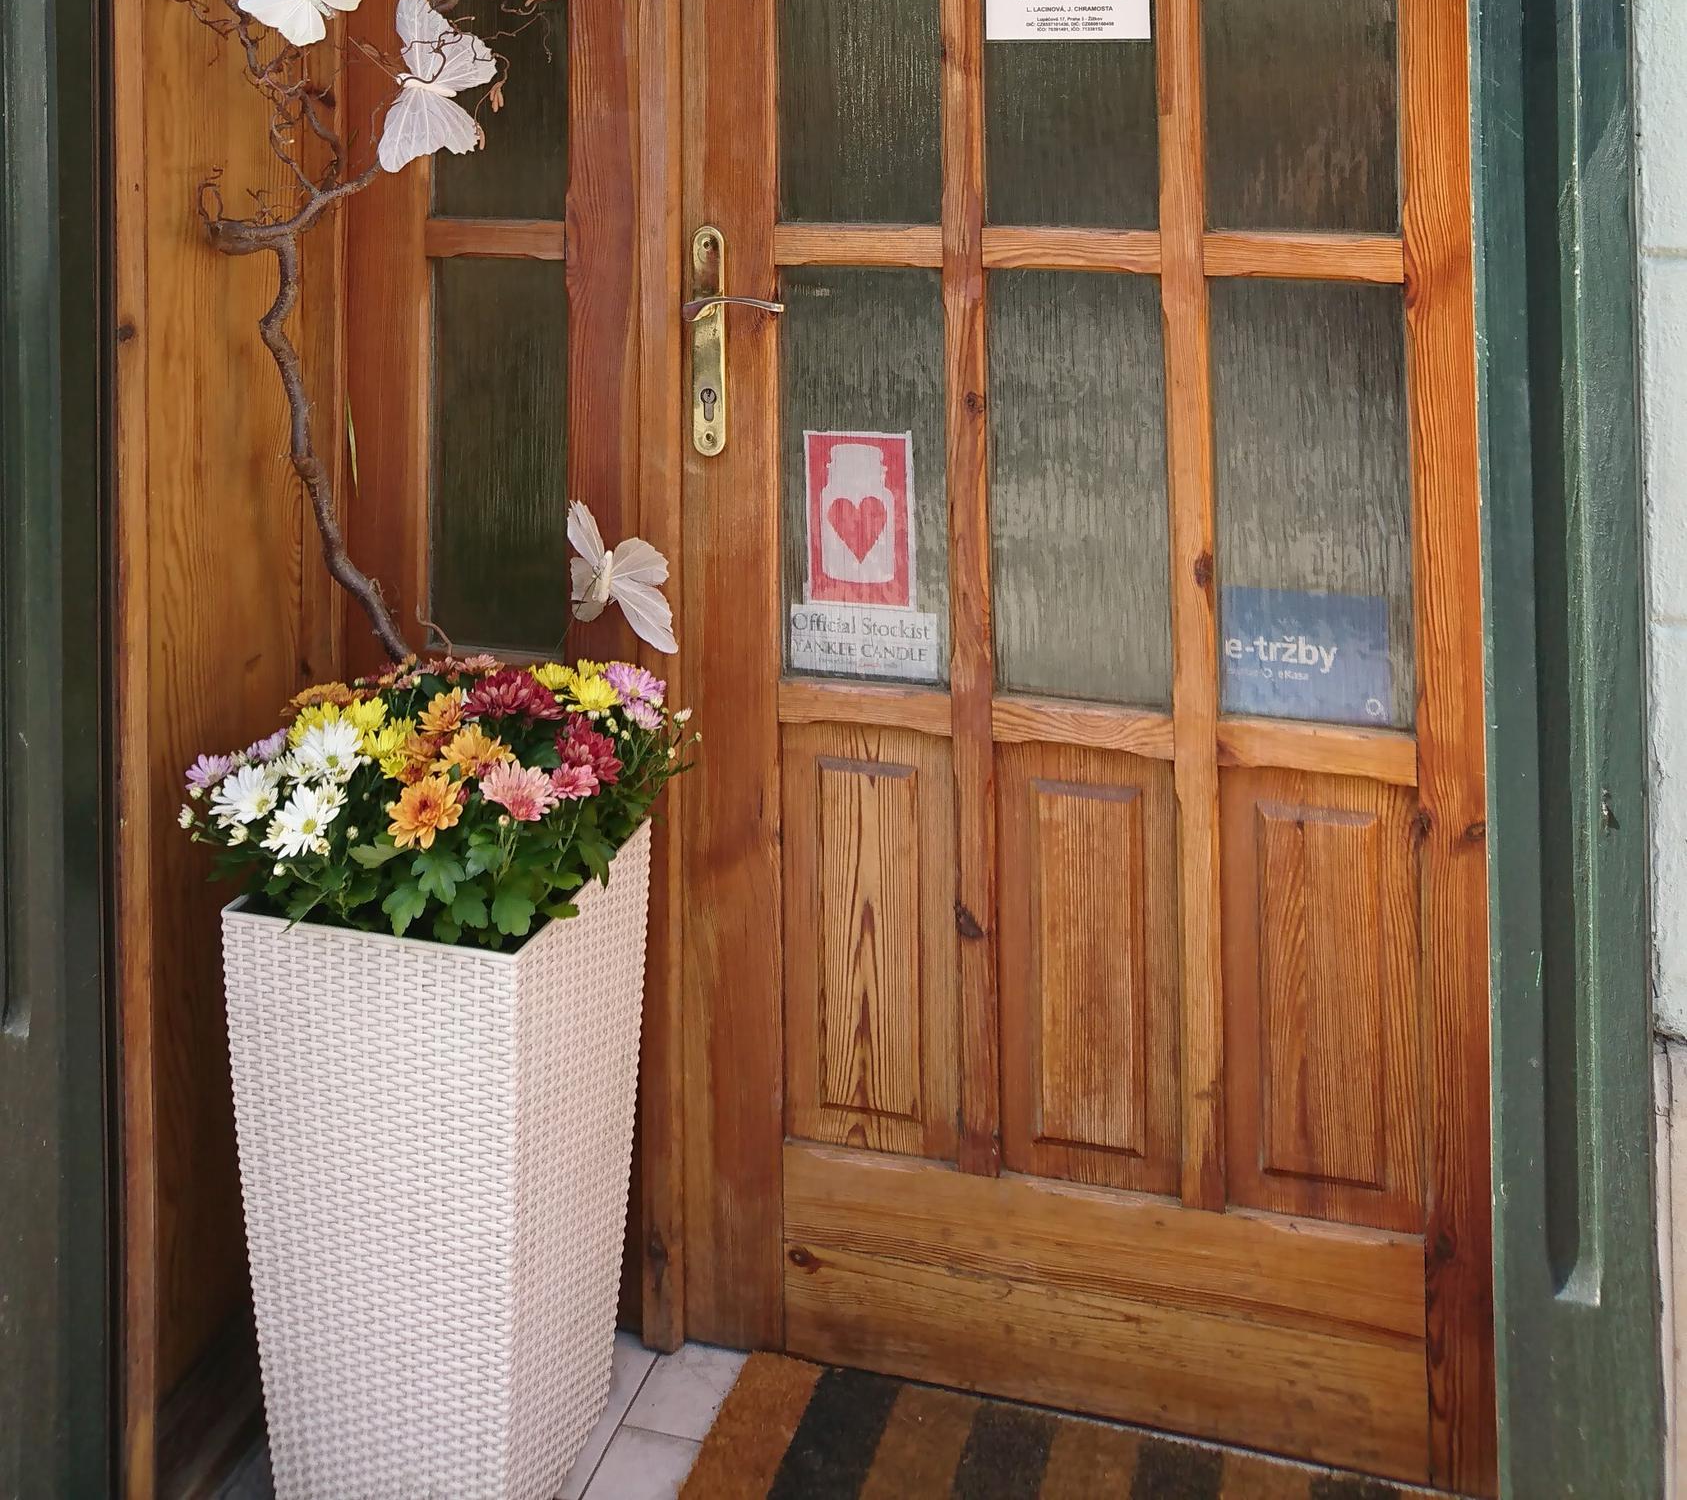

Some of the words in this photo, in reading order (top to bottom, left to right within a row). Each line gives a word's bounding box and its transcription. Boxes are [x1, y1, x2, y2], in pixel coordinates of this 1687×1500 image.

[792, 612, 856, 634] Official
[861, 617, 931, 640] Stockist
[793, 638, 857, 656] YANKEE
[860, 643, 928, 662] CANDLE
[1225, 635, 1338, 674] e-tržby
